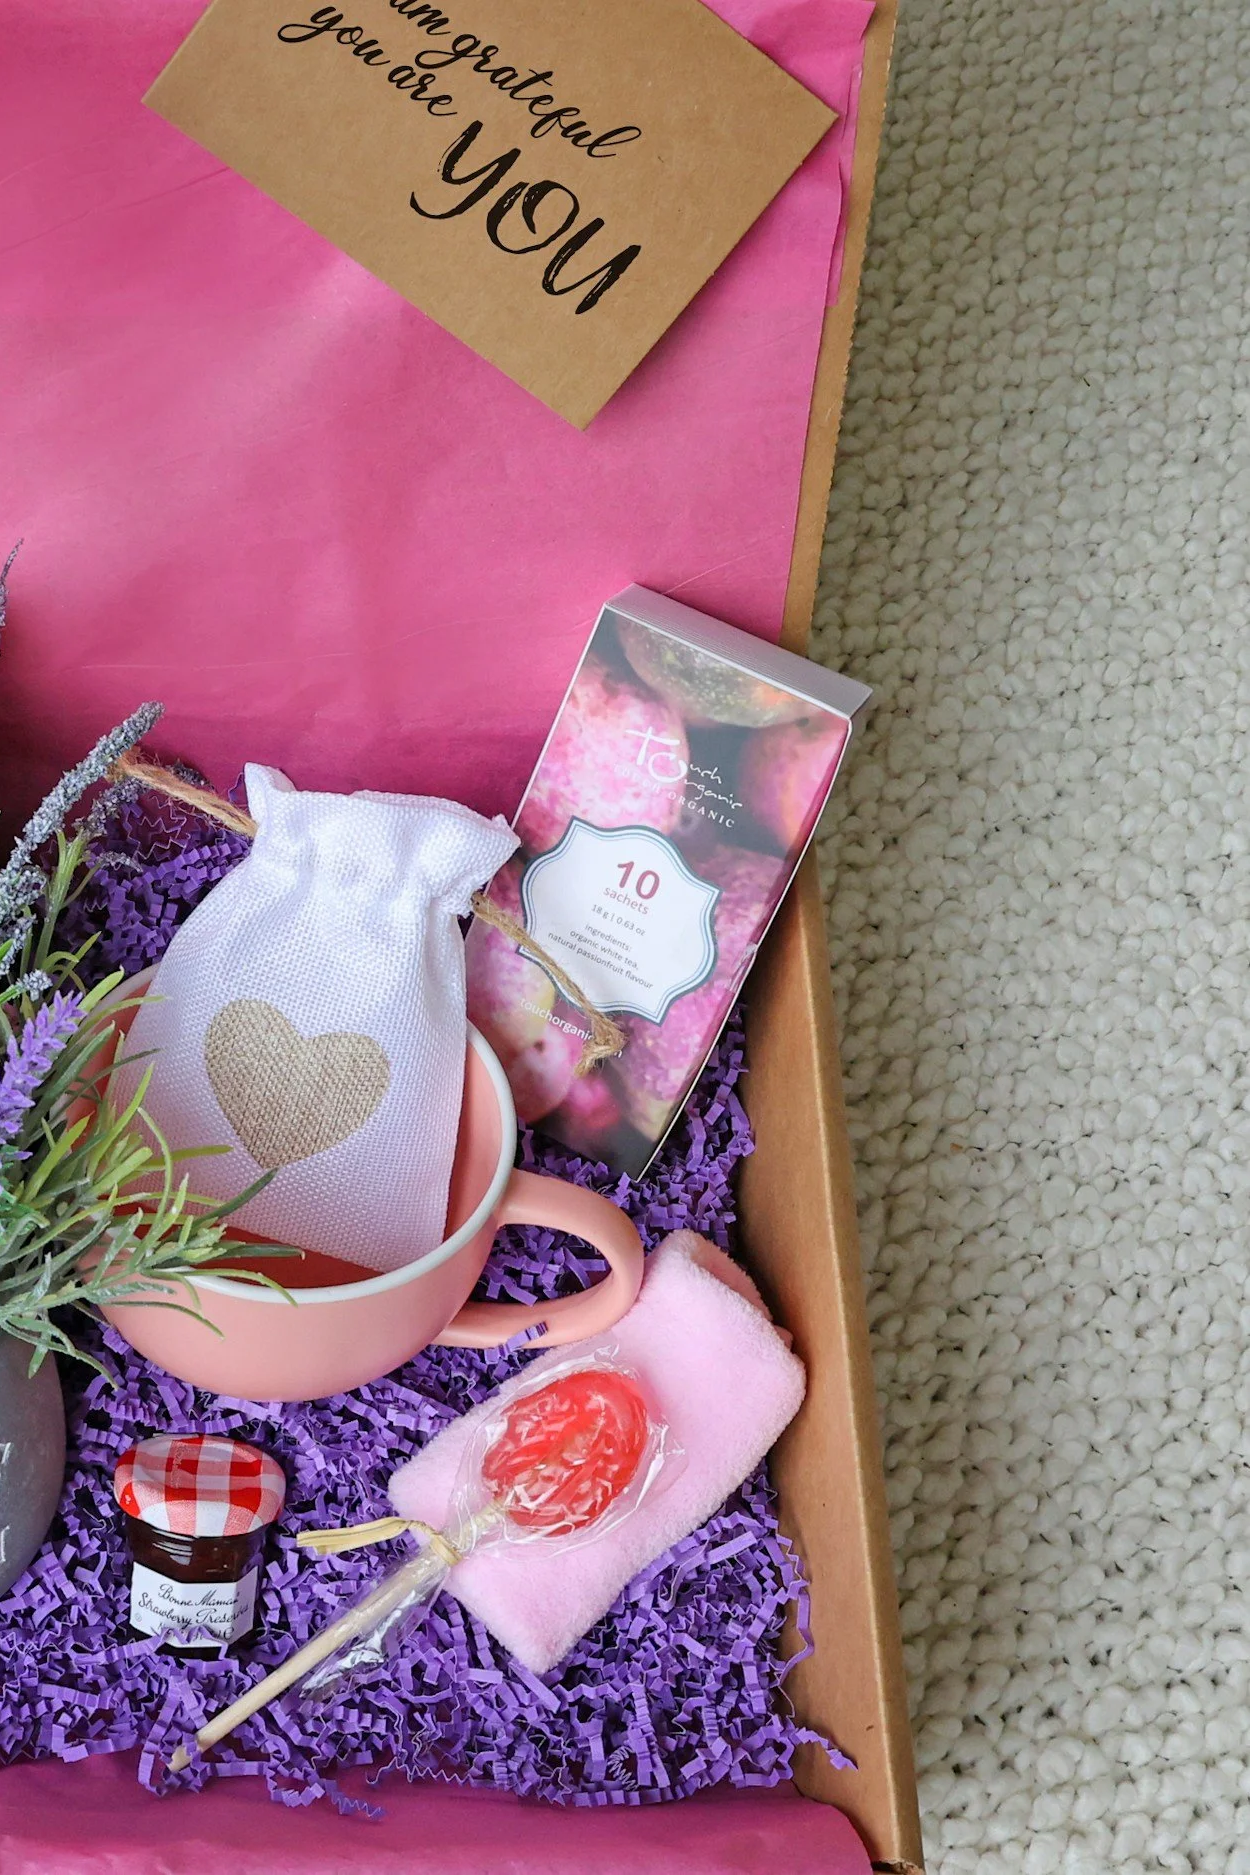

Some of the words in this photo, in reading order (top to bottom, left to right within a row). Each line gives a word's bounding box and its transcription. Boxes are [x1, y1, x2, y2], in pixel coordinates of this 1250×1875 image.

[278, 6, 391, 66] you
[388, 65, 458, 116] are
[415, 34, 642, 158] grateful
[668, 791, 736, 828] ORGANIC
[617, 861, 660, 900] 10
[603, 887, 650, 915] sachets
[591, 904, 602, 914] 18
[616, 916, 635, 931] 0.63
[635, 927, 646, 936] oz
[547, 932, 577, 950] natural
[577, 947, 627, 975] passionfruit
[624, 971, 654, 989] flavour
[570, 930, 599, 949] organic
[600, 945, 623, 961] white
[138, 1592, 193, 1629] Strawberry
[158, 1583, 194, 1606] Bonne
